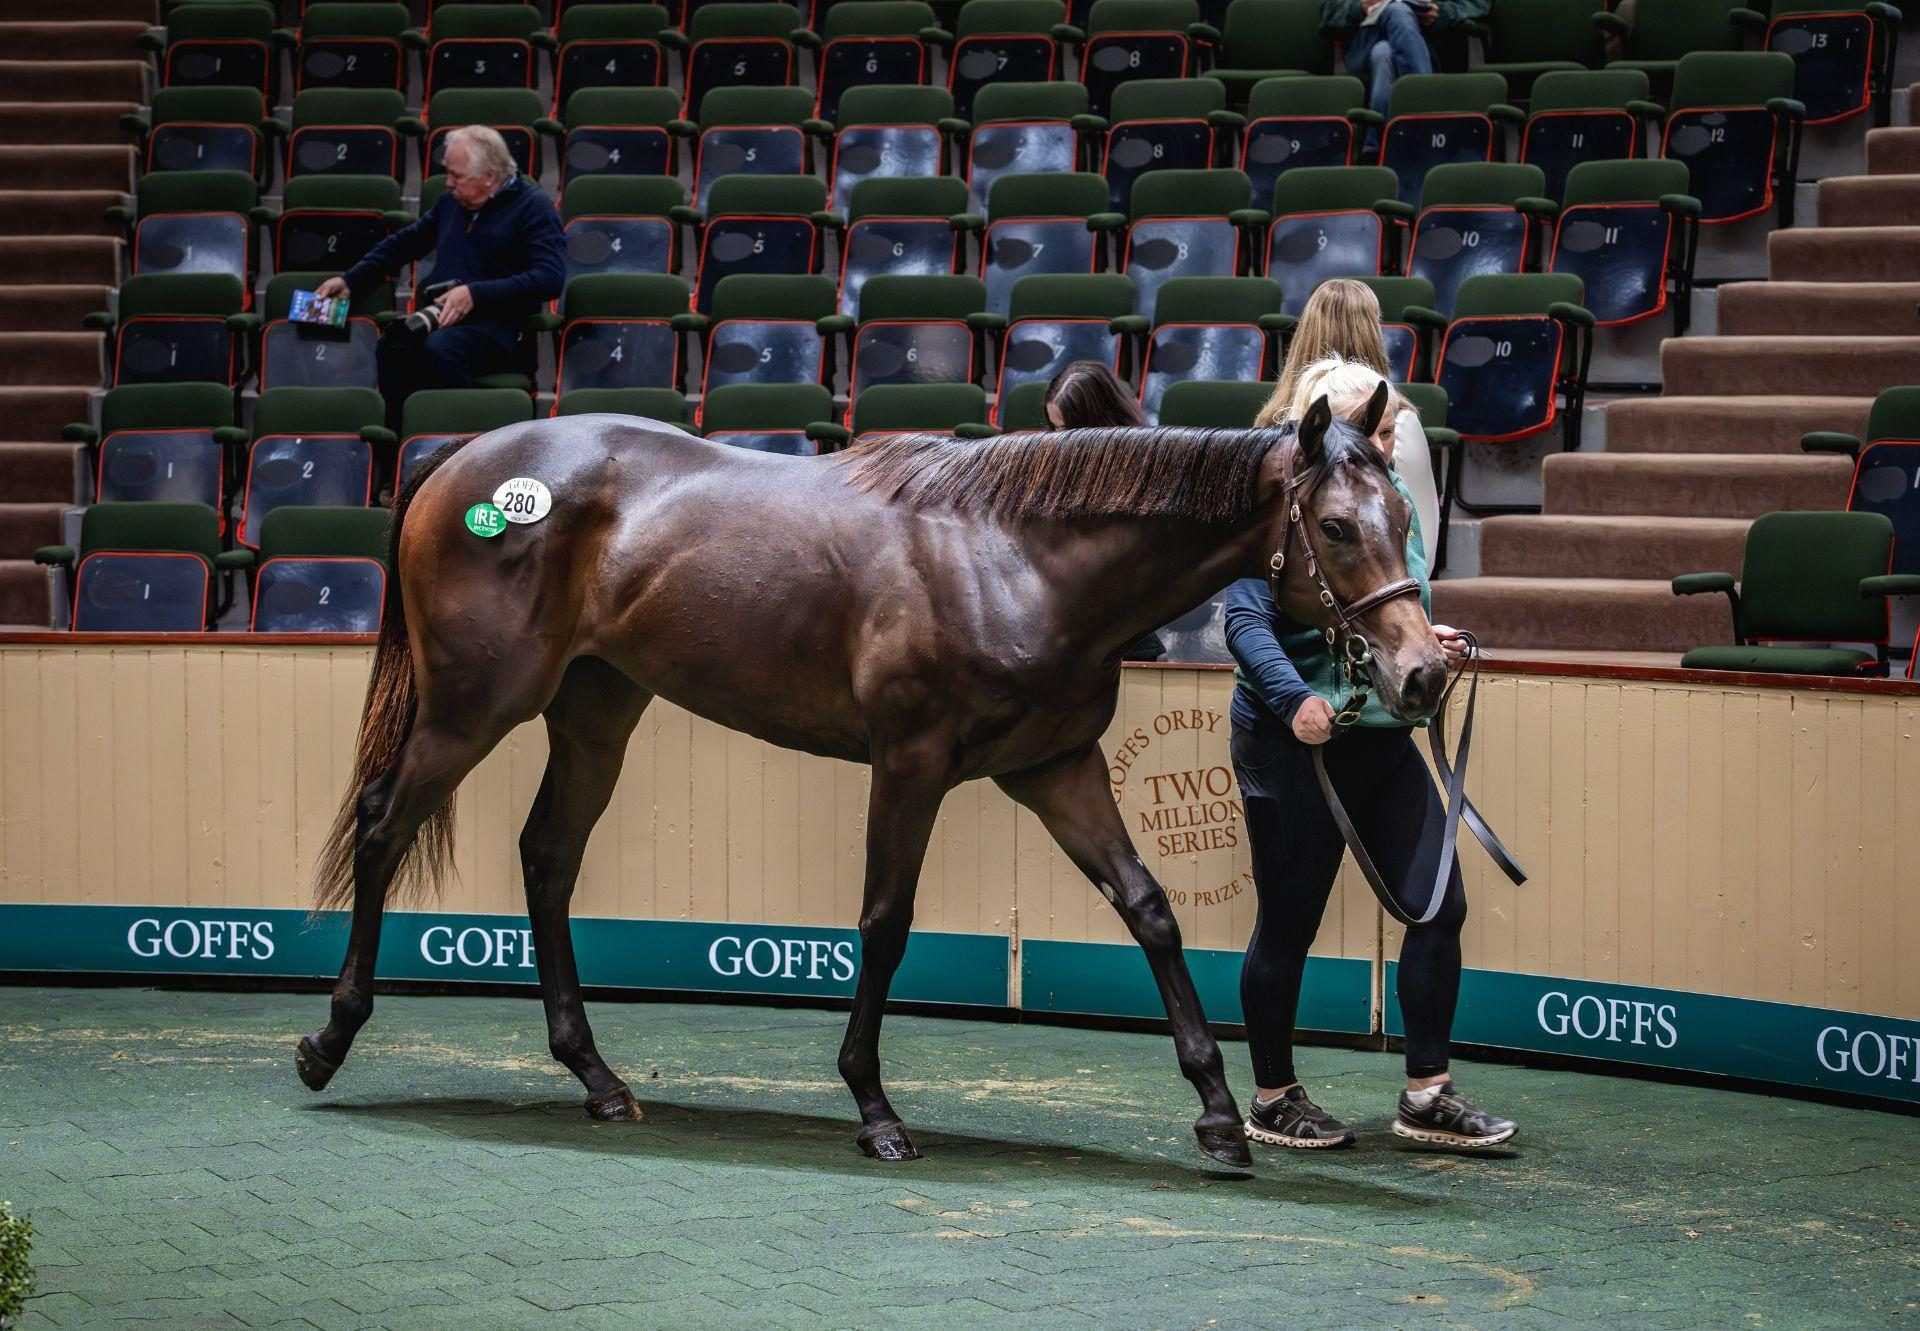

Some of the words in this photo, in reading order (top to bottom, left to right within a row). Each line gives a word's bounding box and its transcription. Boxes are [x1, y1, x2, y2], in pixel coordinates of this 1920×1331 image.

[1811, 34, 1828, 48] 13
[216, 58, 221, 71] 1
[347, 55, 356, 71] 2
[606, 60, 615, 73] 4
[866, 59, 877, 72] 6
[998, 57, 1008, 70] 7
[1130, 51, 1140, 67] 8
[475, 61, 485, 73] 3
[735, 62, 746, 75] 5
[1431, 133, 1446, 148] 10
[1573, 134, 1583, 147] 11
[1711, 128, 1724, 142] 12
[198, 145, 202, 157] 1
[338, 144, 347, 159] 2
[1016, 148, 1026, 160] 7
[1154, 144, 1163, 158] 8
[1290, 141, 1300, 153] 9
[609, 149, 620, 162] 4
[746, 149, 755, 161] 5
[1318, 236, 1327, 249] 9
[1462, 232, 1479, 246] 10
[1606, 228, 1617, 243] 11
[328, 235, 337, 252] 2
[612, 238, 621, 251] 4
[754, 240, 763, 253] 5
[893, 243, 903, 256] 6
[1033, 244, 1043, 257] 7
[1178, 243, 1188, 259] 8
[188, 246, 192, 259] 1
[316, 345, 325, 360] 2
[610, 346, 622, 362] 4
[760, 348, 772, 362] 5
[907, 349, 916, 361] 6
[1052, 344, 1065, 360] 7
[1496, 341, 1511, 356] 10
[171, 350, 176, 366] 1
[168, 463, 172, 478] 1
[303, 461, 313, 478] 2
[509, 479, 542, 493] GOFFS
[503, 492, 536, 514] 280
[474, 508, 499, 527] IRE
[144, 584, 149, 599] 1
[319, 587, 330, 604] 2
[1212, 602, 1223, 620] 7
[1153, 709, 1223, 735] ORBY
[1144, 766, 1232, 805] TWO
[1139, 798, 1245, 833] MILLION
[1158, 826, 1238, 857] SERIES
[1193, 880, 1243, 906] PRIZE
[127, 919, 275, 960] GOFFS
[708, 937, 856, 981] GOFFS
[1537, 991, 1678, 1049] GOFFS
